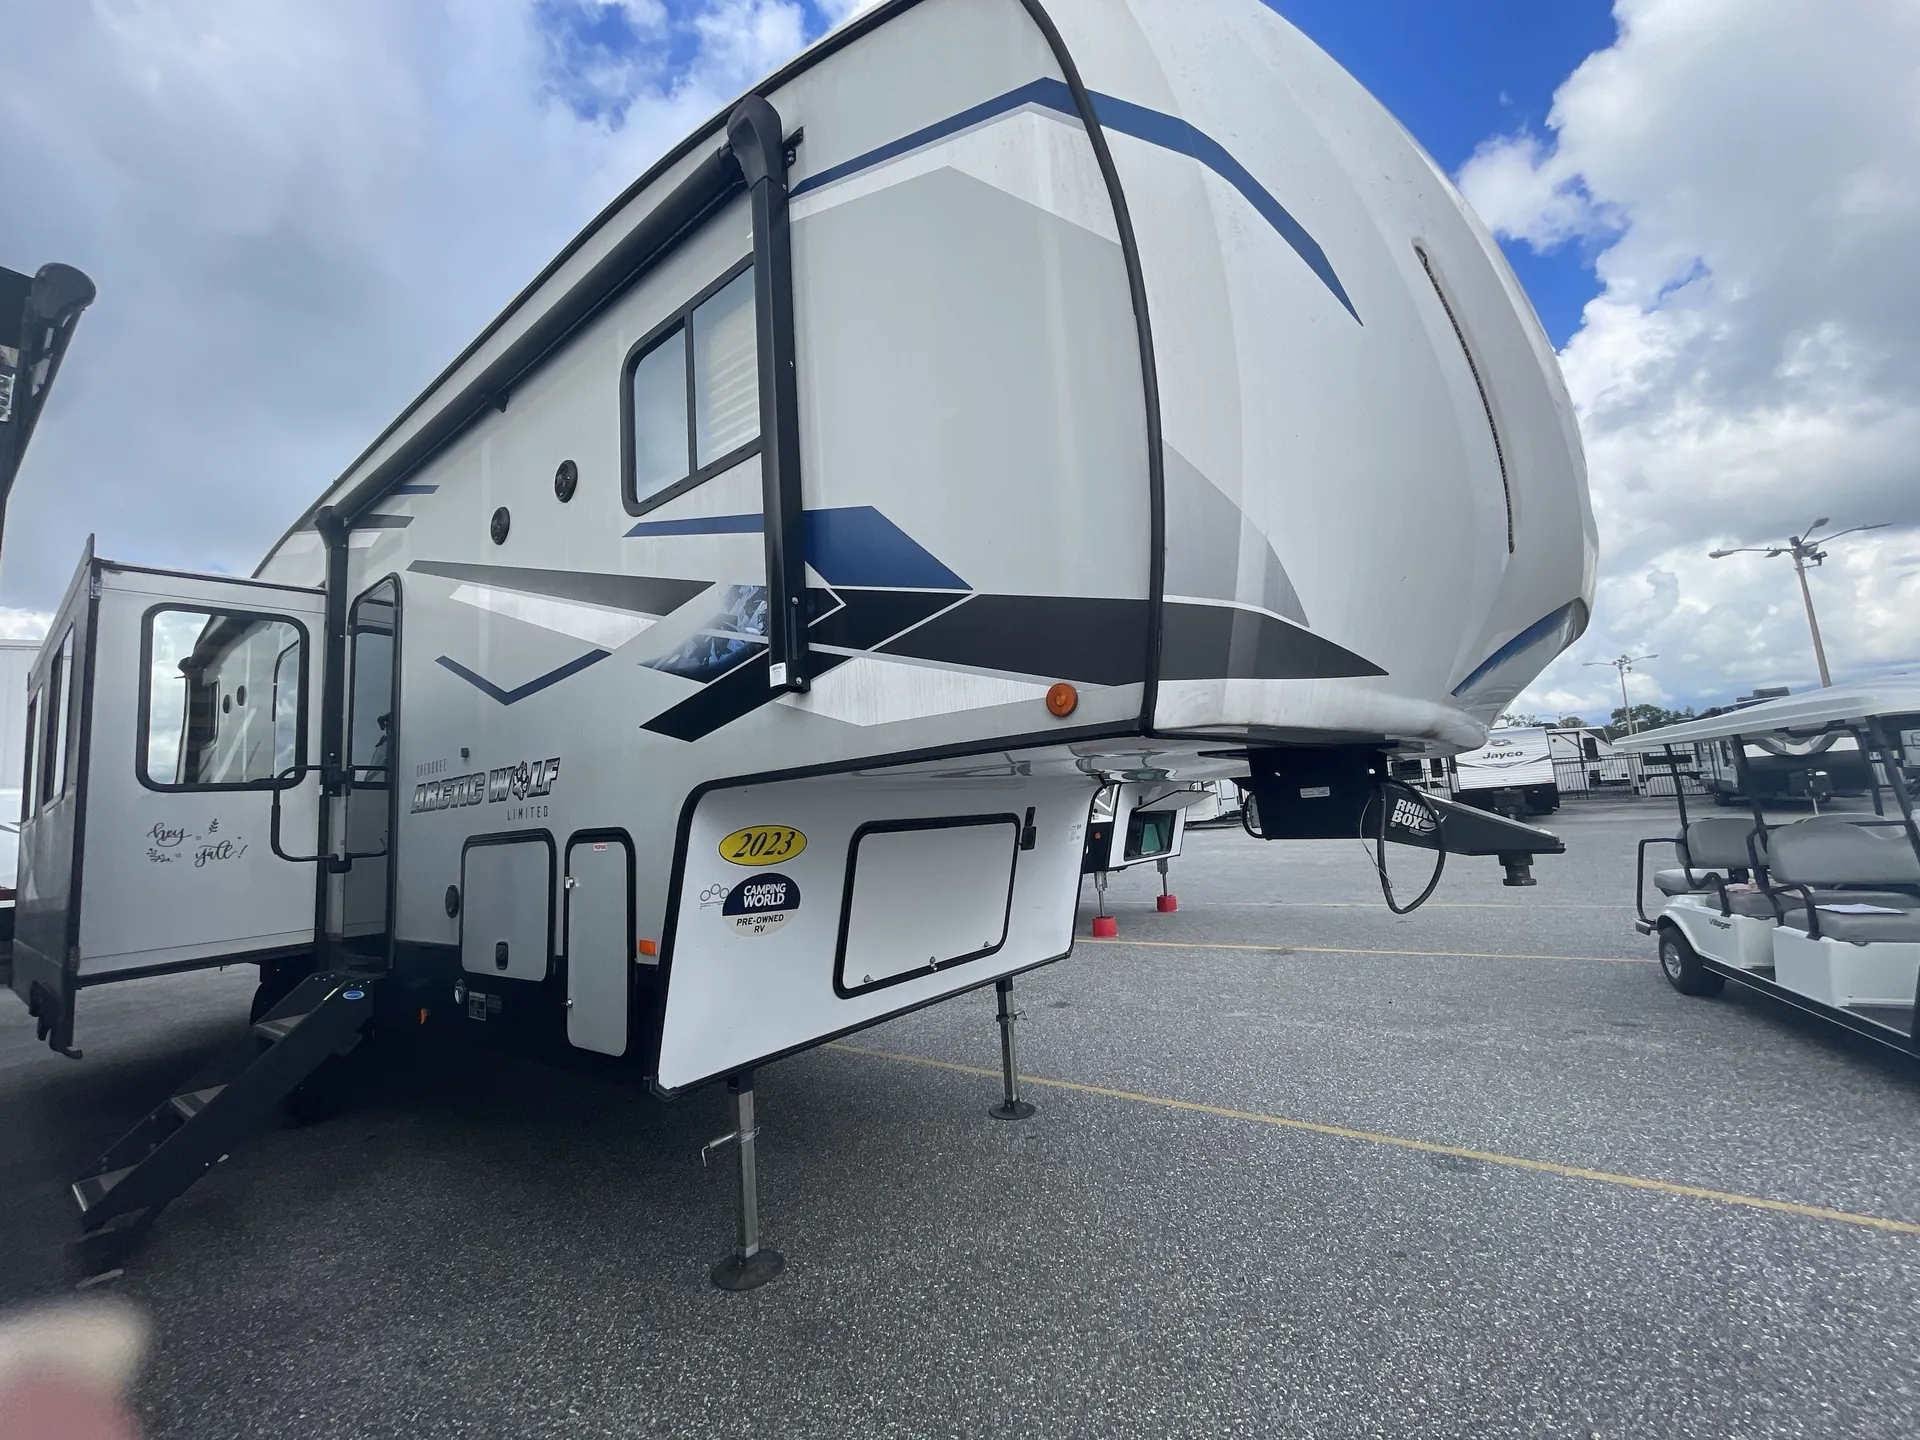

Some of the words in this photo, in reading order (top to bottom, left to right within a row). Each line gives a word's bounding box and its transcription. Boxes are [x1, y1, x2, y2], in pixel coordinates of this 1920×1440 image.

[1482, 751, 1524, 760] Jayco
[416, 758, 447, 777] CHEROKEE
[410, 772, 486, 814] ARCTIC
[507, 805, 549, 821] LIMITED
[1391, 809, 1423, 830] BOX
[146, 822, 193, 848] hey
[732, 831, 796, 858] 2023
[743, 883, 786, 897] CAMPING
[743, 893, 785, 909] WORLD
[736, 914, 785, 927] PRE-OWNED
[753, 925, 766, 934] RV
